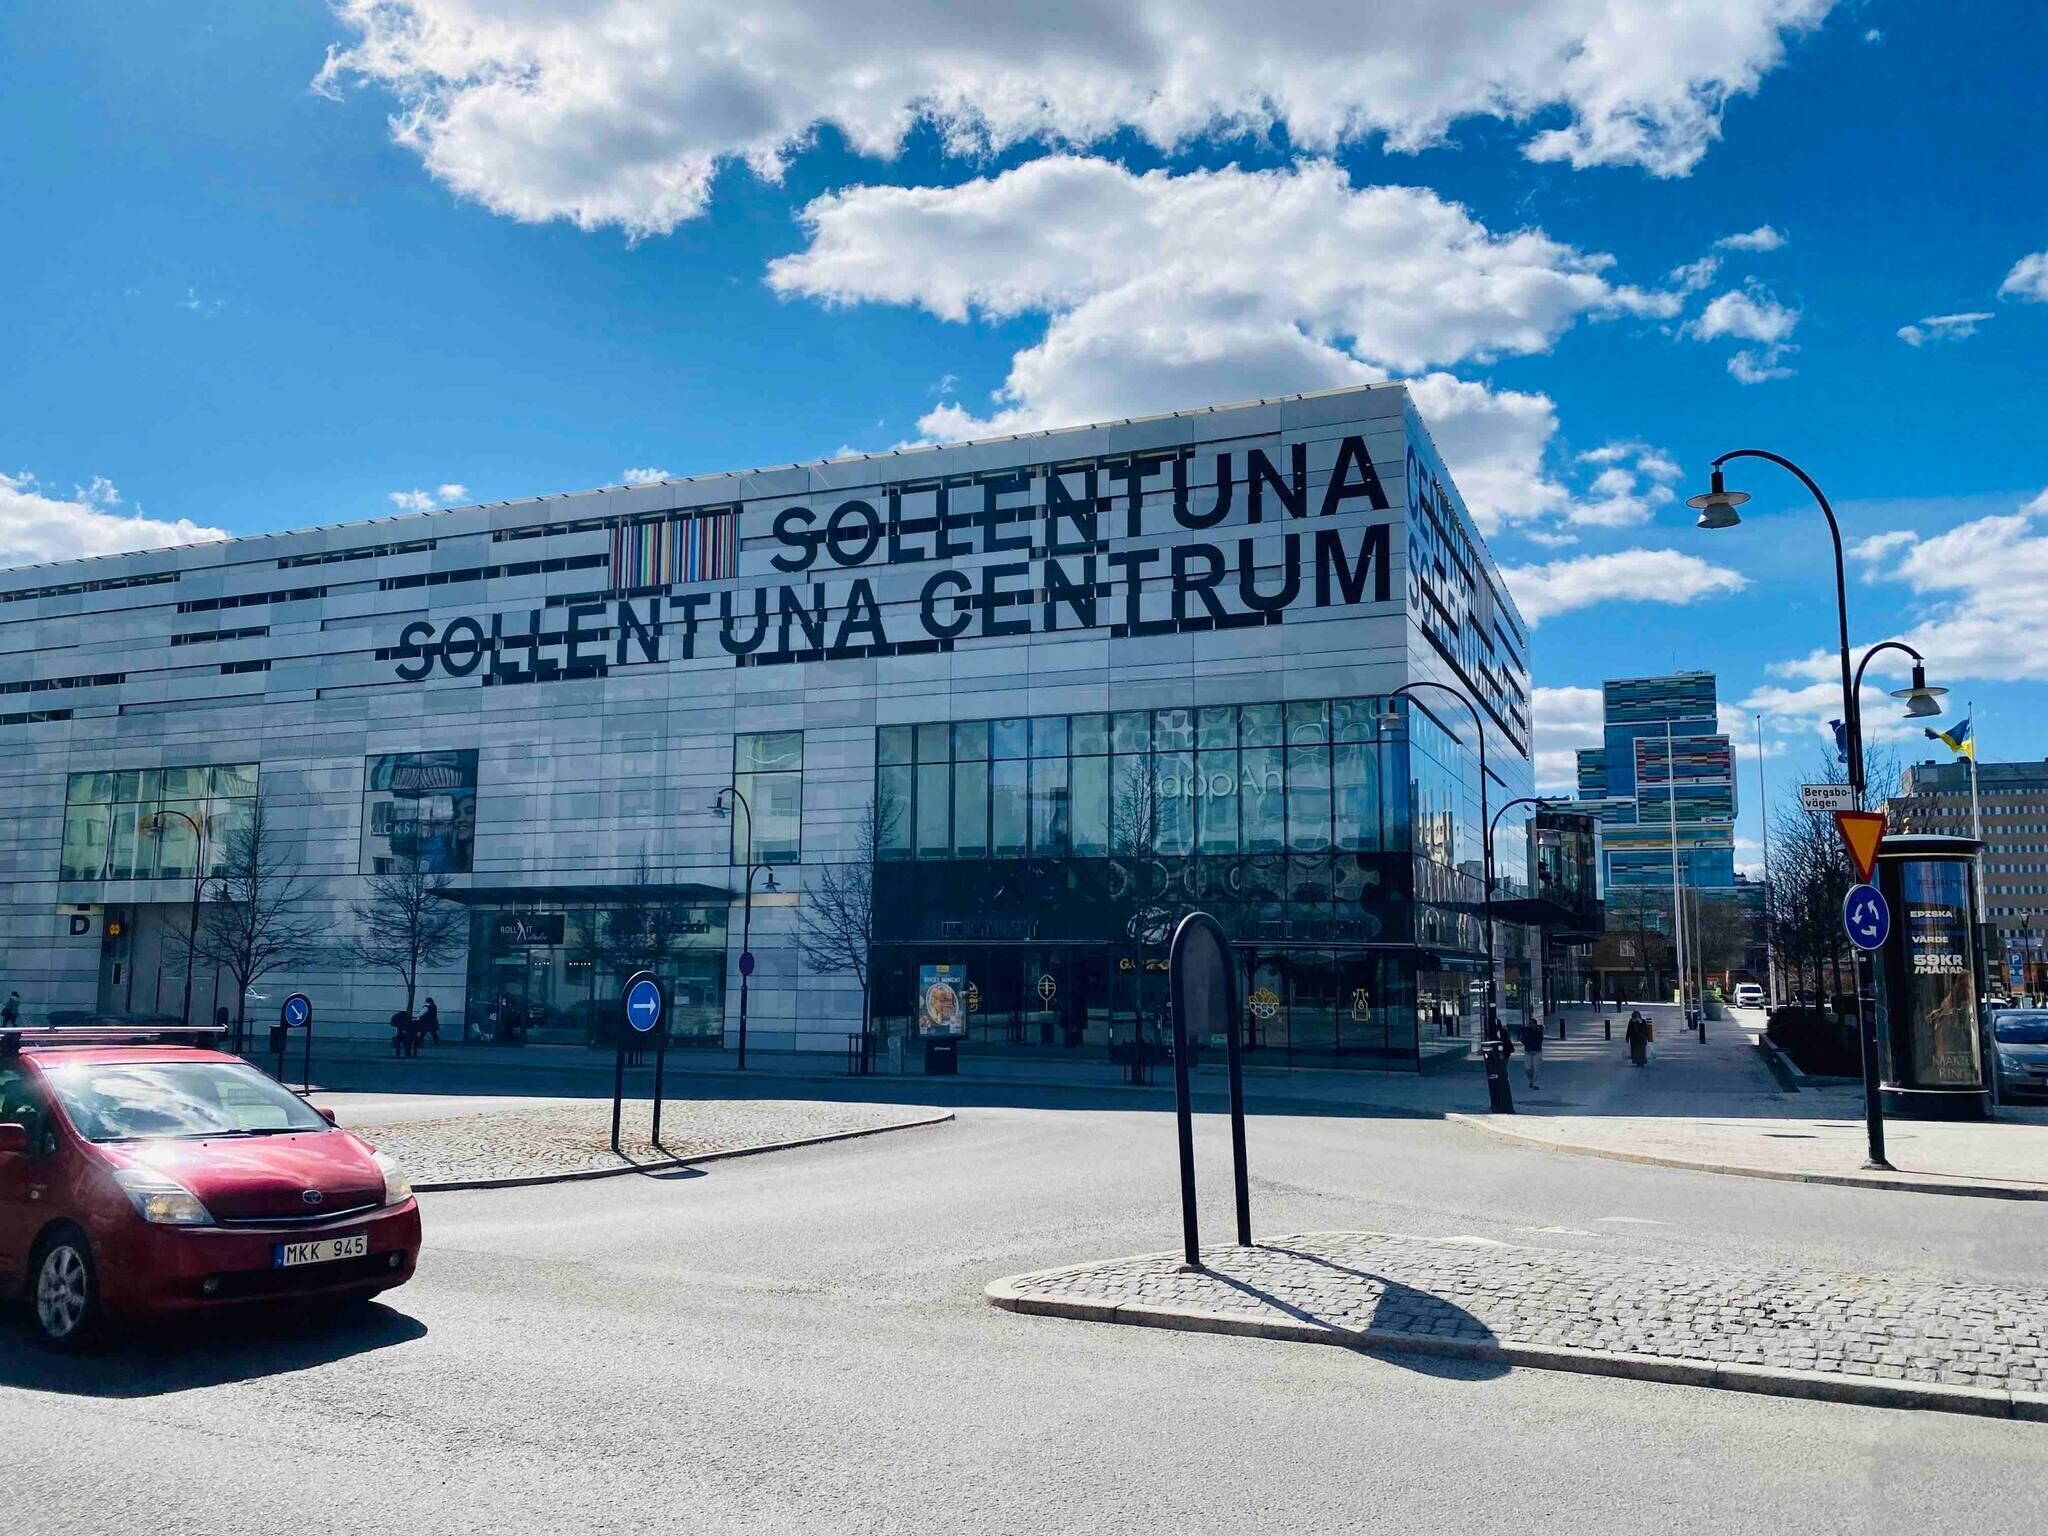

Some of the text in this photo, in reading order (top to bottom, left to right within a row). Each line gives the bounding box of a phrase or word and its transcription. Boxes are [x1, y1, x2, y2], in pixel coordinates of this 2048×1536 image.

[770, 435, 1391, 573] SOLLENTUNA
[395, 524, 1392, 681] SOLLENTUNA CENTRUM
[1804, 787, 1851, 799] Bergsbo-
[1805, 799, 1838, 809] vägen
[369, 821, 410, 835] KICKS
[1910, 910, 1953, 918] EPISKA
[69, 914, 91, 936] D
[2011, 954, 2020, 964] P
[286, 1237, 364, 1265] MKK 945
